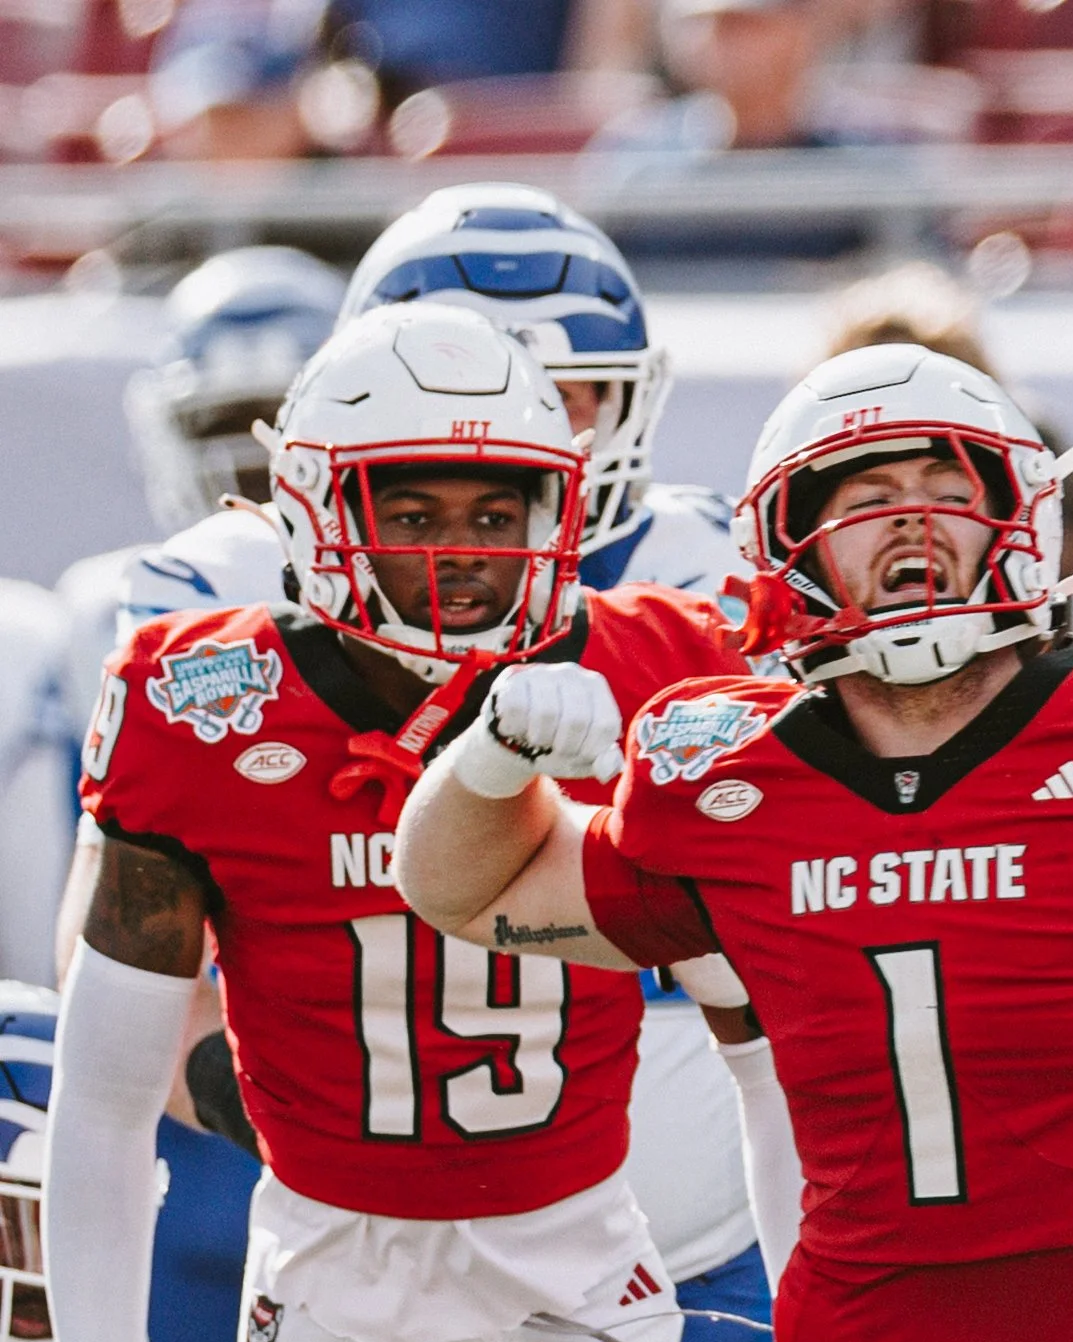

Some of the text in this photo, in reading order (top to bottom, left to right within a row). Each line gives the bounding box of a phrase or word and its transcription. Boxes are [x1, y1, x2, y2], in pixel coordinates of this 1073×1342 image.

[451, 420, 492, 440] HTT
[843, 406, 882, 430] HTT
[250, 752, 293, 768] ACC
[709, 788, 749, 807] ACC
[791, 844, 1027, 915] NC STATE
[349, 914, 569, 1143] 19
[861, 941, 968, 1207] 1
